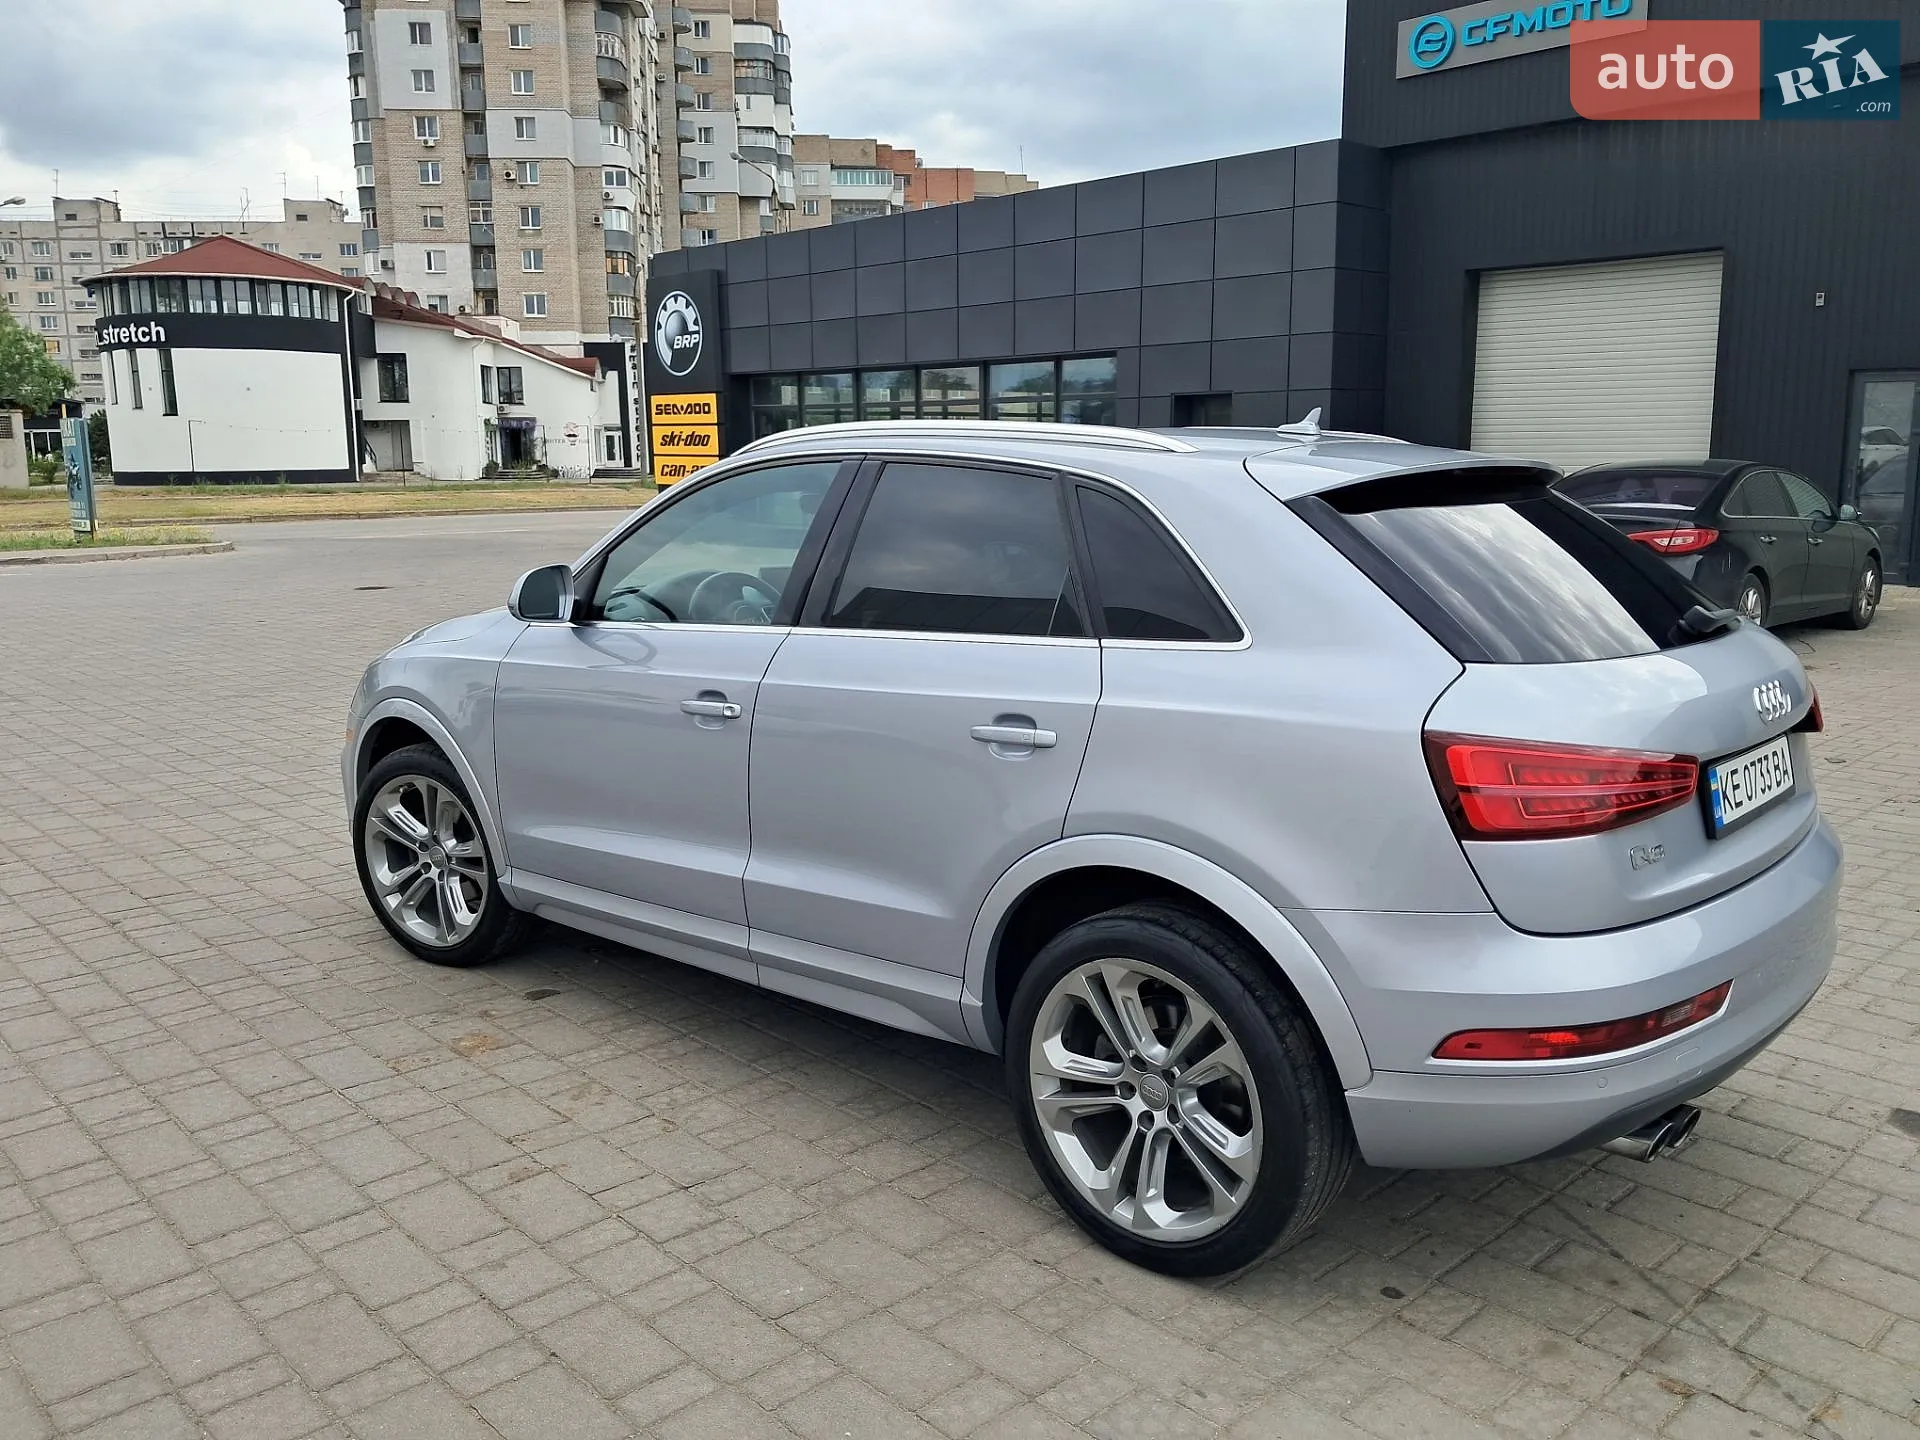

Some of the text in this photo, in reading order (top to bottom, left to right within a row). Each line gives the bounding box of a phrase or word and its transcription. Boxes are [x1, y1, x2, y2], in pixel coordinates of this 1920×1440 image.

[1462, 0, 1632, 46] CFMOTO
[673, 335, 700, 349] BRP
[660, 431, 711, 446] ski-doo
[660, 464, 709, 477] can-a
[1719, 747, 1790, 814] KE 0733 BA
